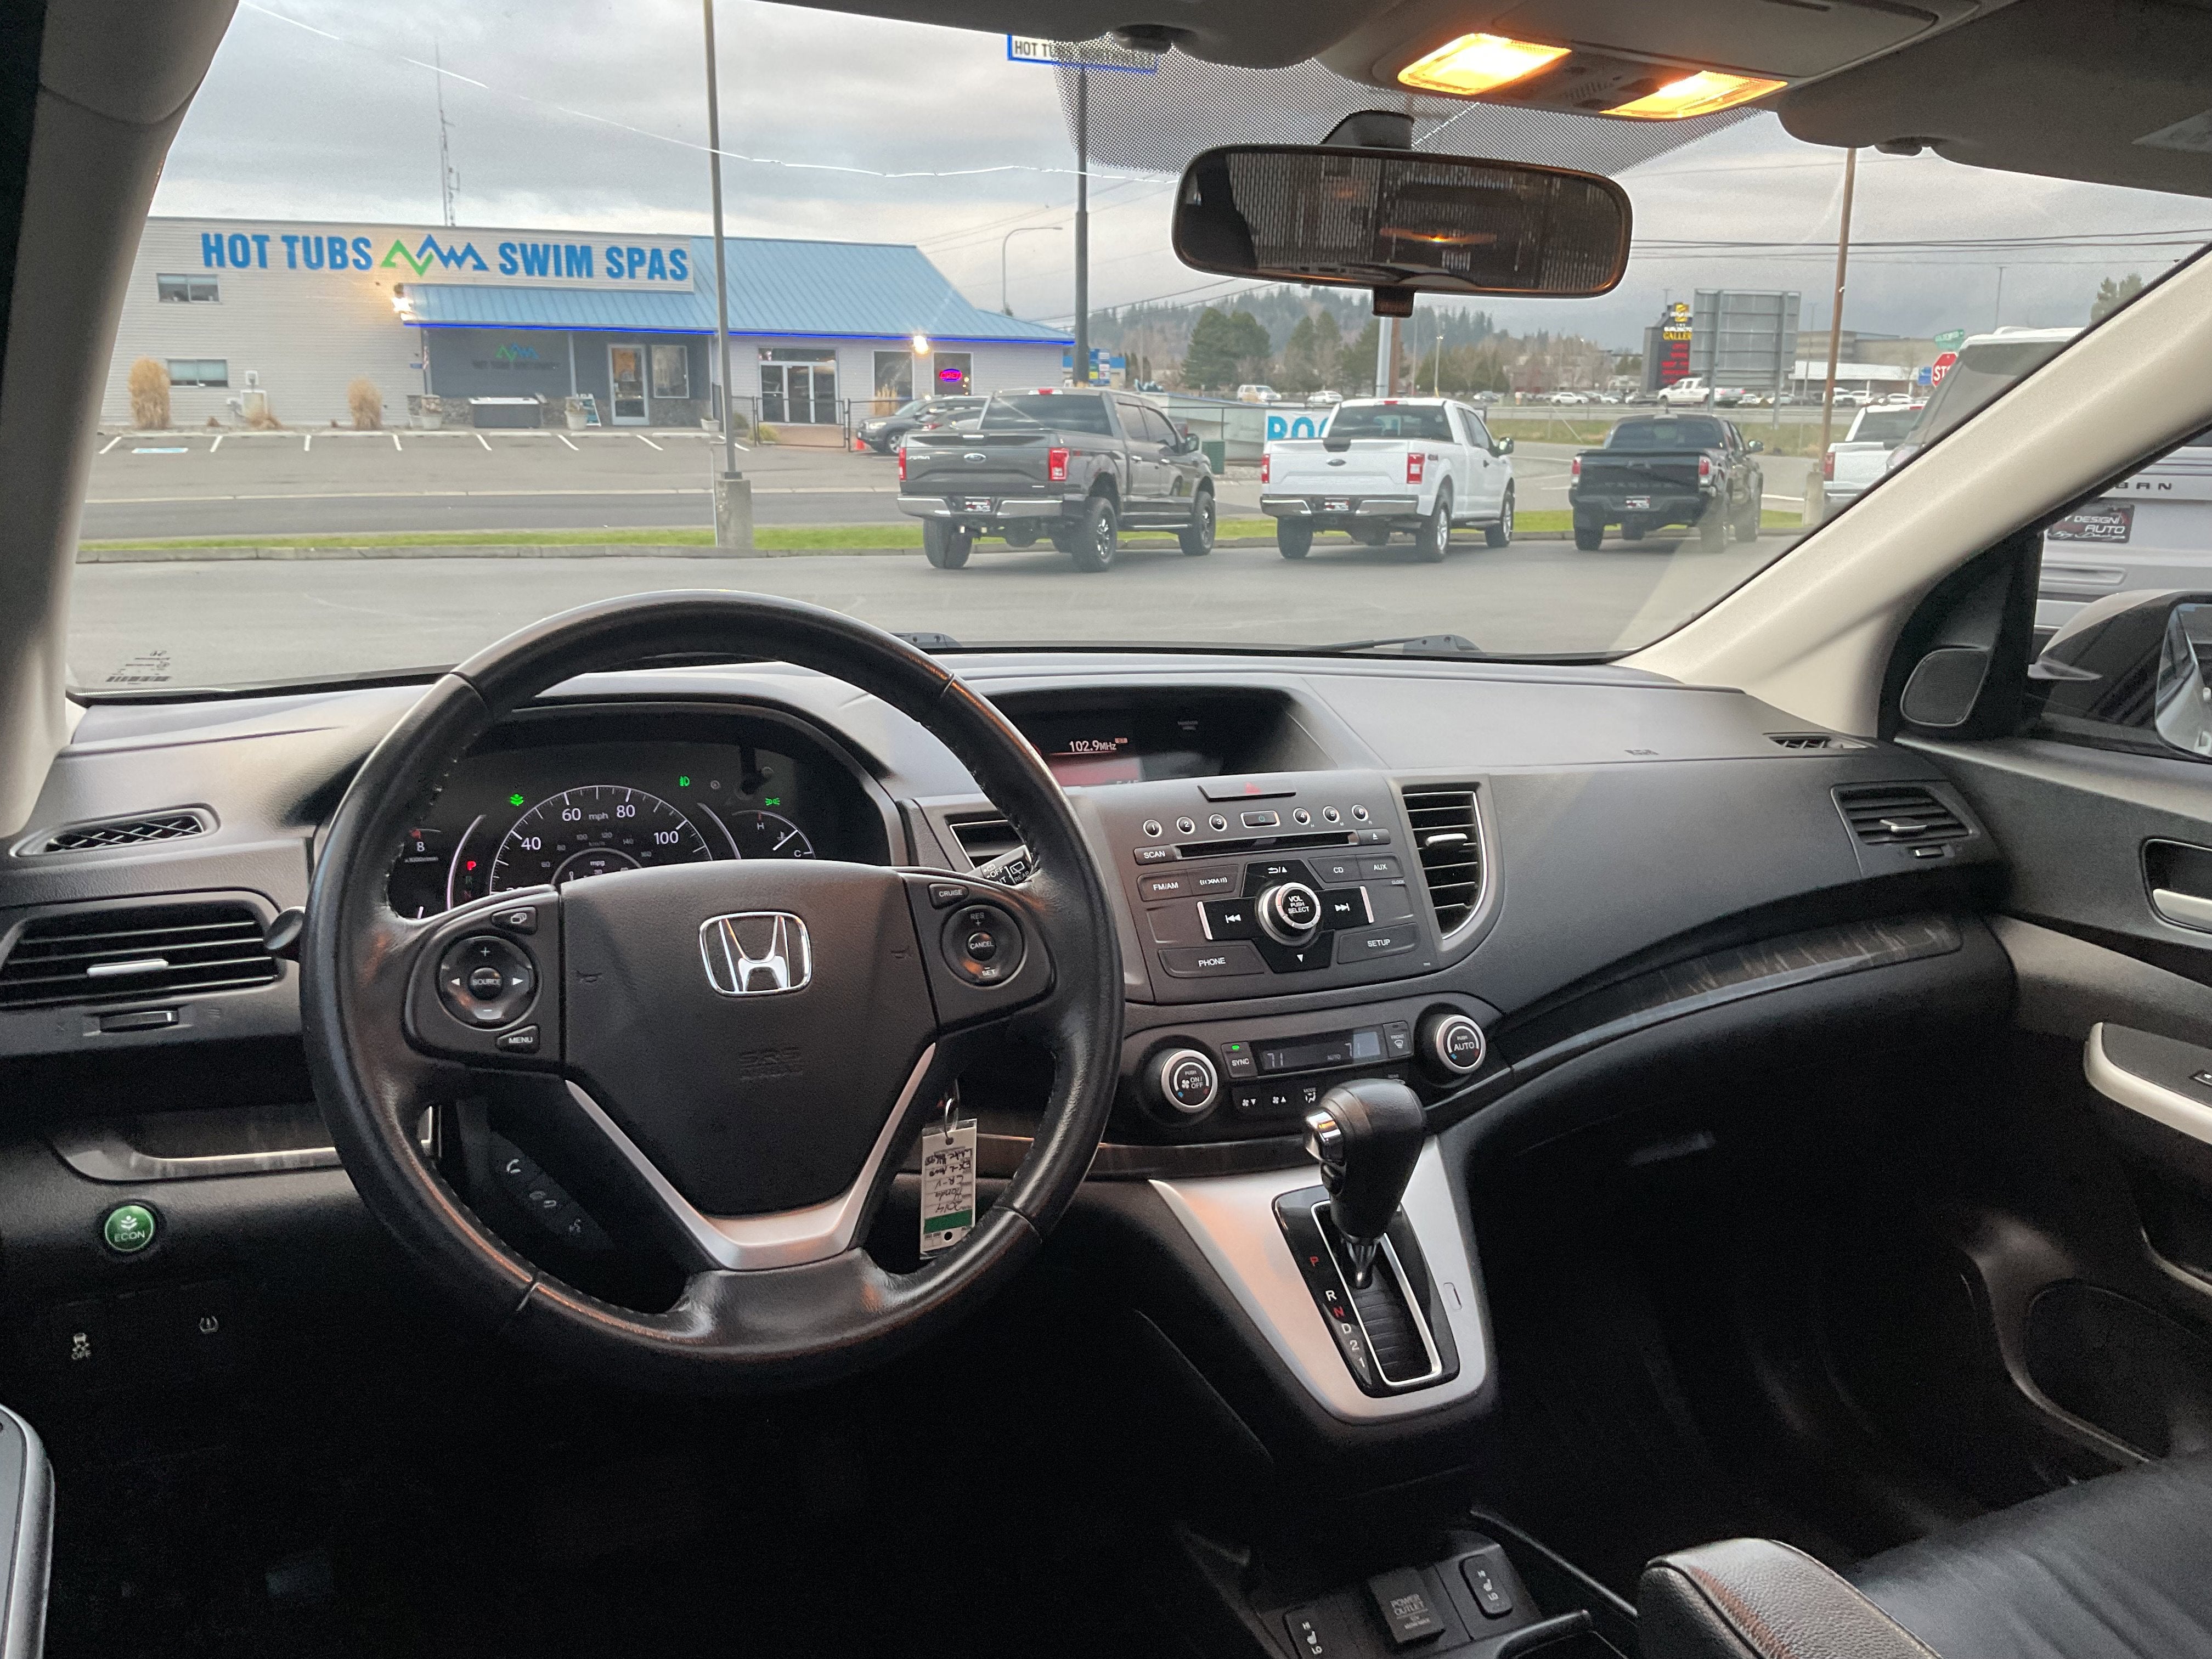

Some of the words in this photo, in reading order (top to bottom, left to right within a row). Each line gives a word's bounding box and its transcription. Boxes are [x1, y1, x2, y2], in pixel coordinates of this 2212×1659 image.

[1015, 41, 1037, 56] HOT
[201, 233, 270, 268] HOT
[281, 235, 373, 270] TUBS
[499, 242, 594, 278] SWIM
[606, 246, 689, 281] SPAS
[1934, 365, 1951, 381] ST
[2074, 515, 2120, 524] DESIGN
[2085, 524, 2125, 534] AUTO
[562, 808, 582, 821] 60
[589, 812, 608, 821] mph
[616, 805, 636, 818] 80
[521, 837, 541, 850] 40
[653, 831, 679, 845] 100
[417, 841, 425, 851] 8
[1143, 850, 1165, 859] SCAN
[990, 866, 1003, 877] OFF
[1153, 882, 1178, 891] FM/AM
[939, 889, 963, 897] CRUISE
[1288, 906, 1310, 914] SELECT
[969, 941, 995, 950] CANCEL
[1367, 939, 1391, 947] SETUP
[1198, 957, 1226, 967] PHONE
[1454, 1041, 1475, 1051] AUTO
[1232, 1058, 1250, 1066] SYNC
[1267, 1053, 1283, 1067] 71
[935, 1200, 963, 1214] 2014
[114, 1230, 145, 1242] ECON
[1310, 1256, 1319, 1266] P
[1325, 1290, 1337, 1301] R
[1333, 1306, 1345, 1317] N
[1341, 1323, 1352, 1334] D
[1350, 1340, 1359, 1351] 2
[1359, 1357, 1365, 1368] 1
[1311, 1646, 1322, 1654] LO
